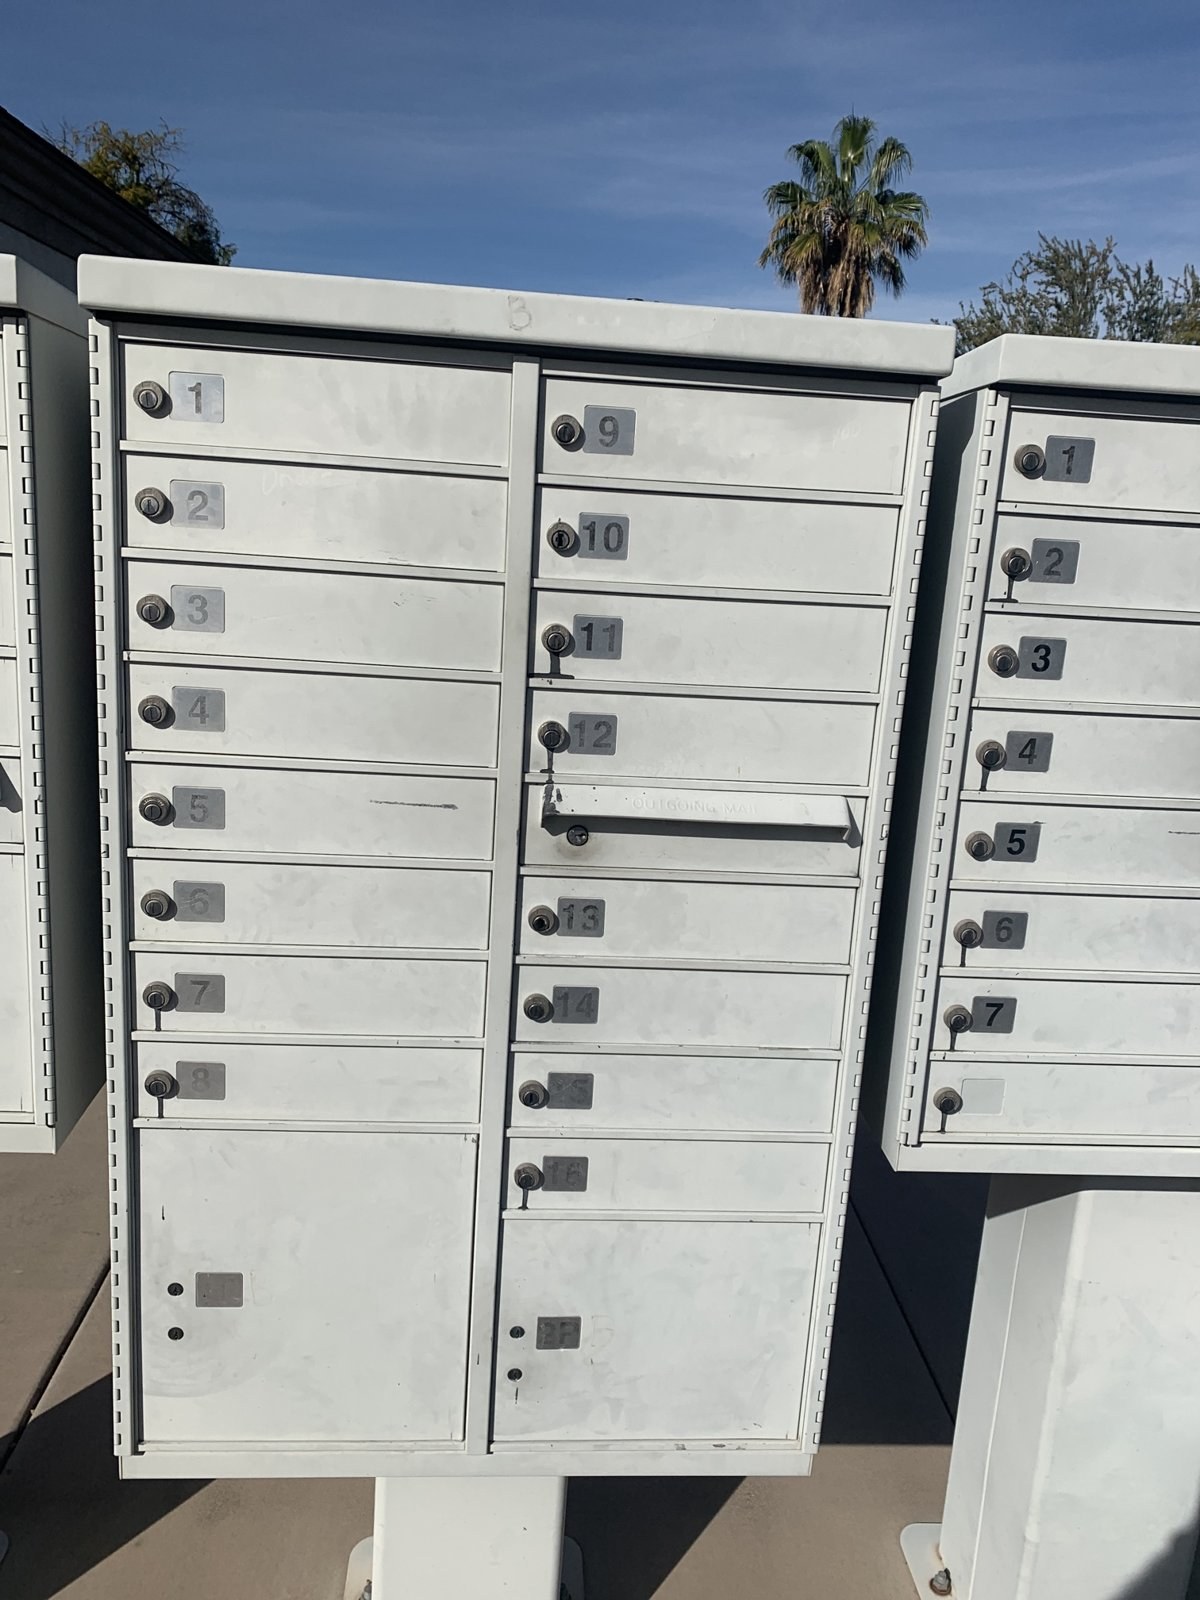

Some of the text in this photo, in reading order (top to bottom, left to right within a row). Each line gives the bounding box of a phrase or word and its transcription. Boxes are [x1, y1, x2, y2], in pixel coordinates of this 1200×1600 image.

[187, 382, 202, 414] 1
[599, 416, 619, 448] 9
[1062, 445, 1076, 476] 1
[187, 489, 208, 521] 2
[582, 521, 624, 553] 10
[1043, 547, 1064, 576] 2
[187, 594, 208, 625] 3
[580, 622, 616, 653] 11
[1031, 644, 1051, 673] 3
[188, 696, 209, 725] 4
[573, 720, 613, 748] 12
[1018, 738, 1038, 765] 4
[190, 794, 208, 822] 5
[1006, 829, 1027, 856] 5
[190, 888, 209, 916] 6
[562, 903, 600, 931] 13
[995, 917, 1014, 943] 6
[189, 980, 210, 1006] 7
[557, 991, 593, 1018] 14
[985, 1002, 1005, 1027] 7
[191, 1067, 210, 1093] 8
